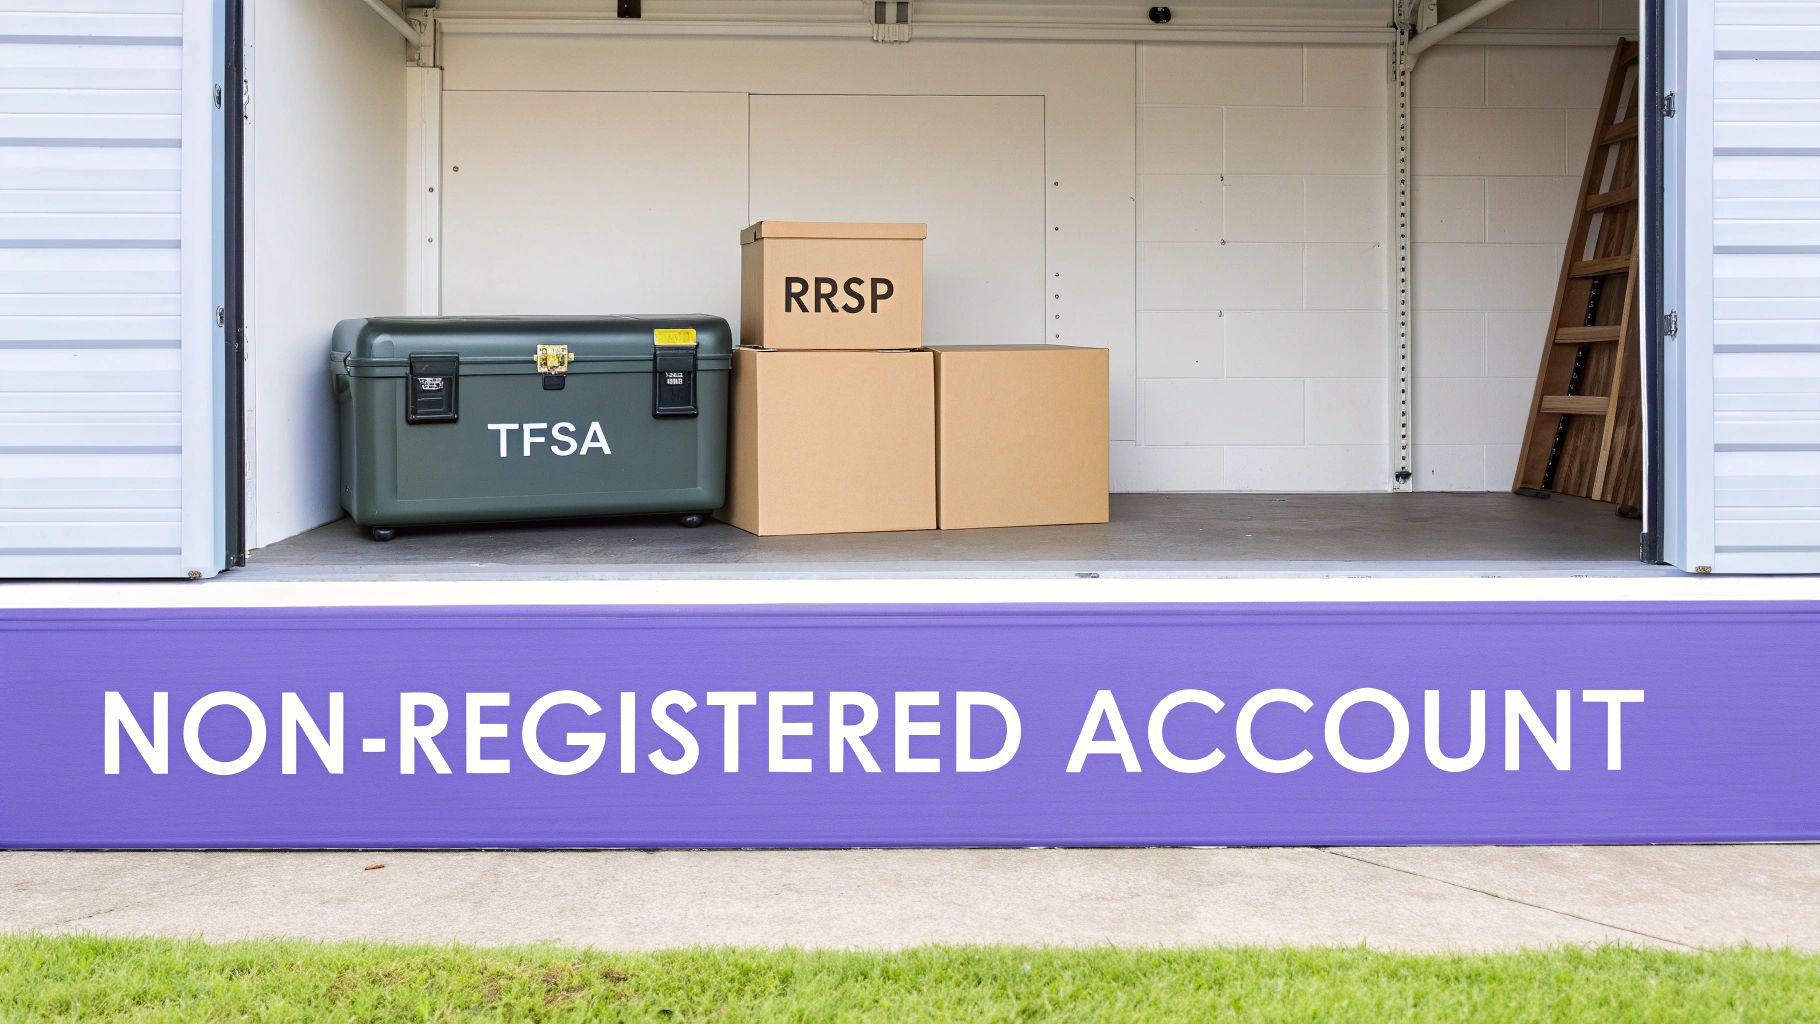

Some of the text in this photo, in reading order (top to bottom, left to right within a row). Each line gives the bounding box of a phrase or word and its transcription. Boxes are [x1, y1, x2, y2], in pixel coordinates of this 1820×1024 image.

[784, 276, 894, 314] RRSP
[487, 421, 612, 458] TFSA
[104, 687, 1645, 776] NON-REGISTERED ACCOUNT
